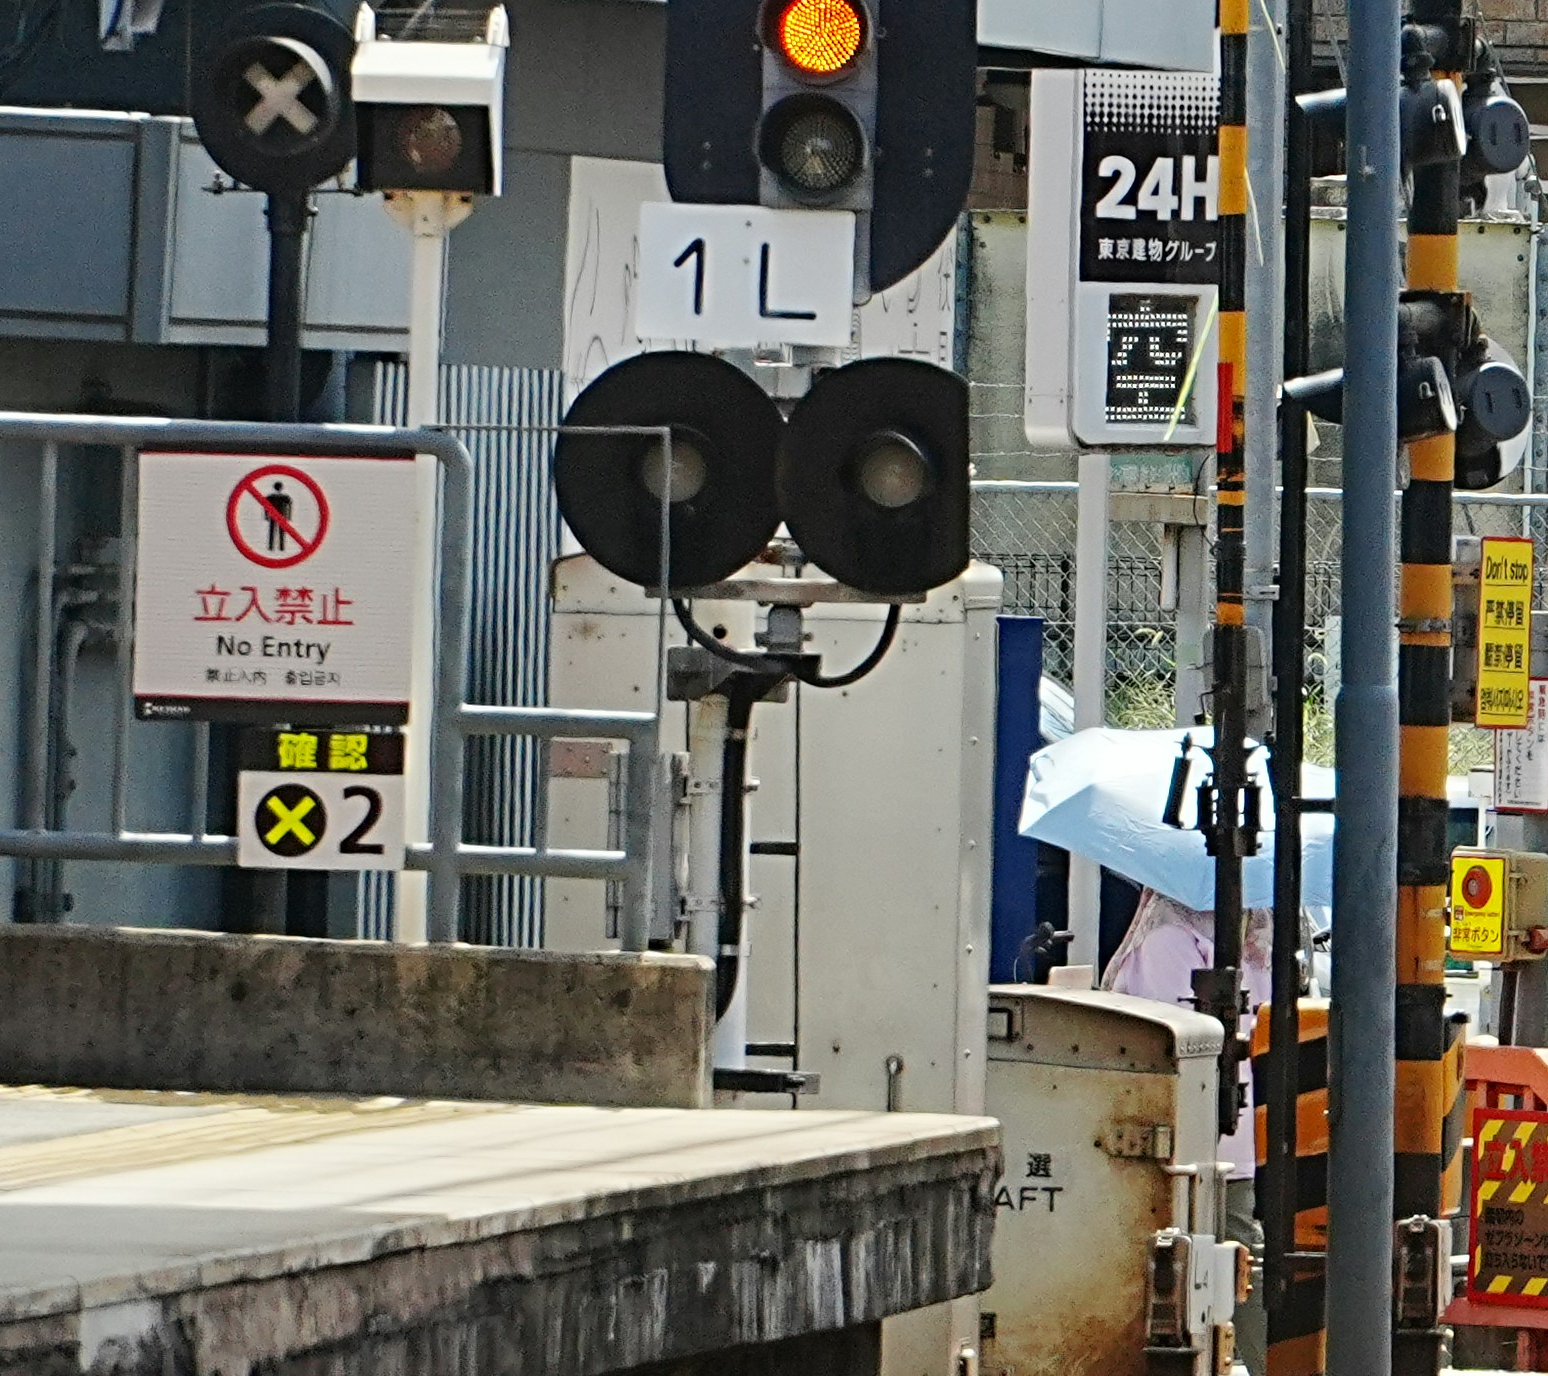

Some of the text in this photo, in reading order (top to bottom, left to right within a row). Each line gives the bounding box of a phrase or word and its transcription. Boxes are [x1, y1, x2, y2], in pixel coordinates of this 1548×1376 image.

[1095, 154, 1220, 222] 24H
[1097, 238, 1218, 263] 東京建物グループ
[1104, 300, 1189, 421] 空
[1485, 555, 1529, 583] Don't stop
[194, 584, 356, 626] 立入禁止
[216, 634, 332, 665] No Entry
[339, 785, 385, 855] 2
[1453, 926, 1499, 943] 非常ボタン
